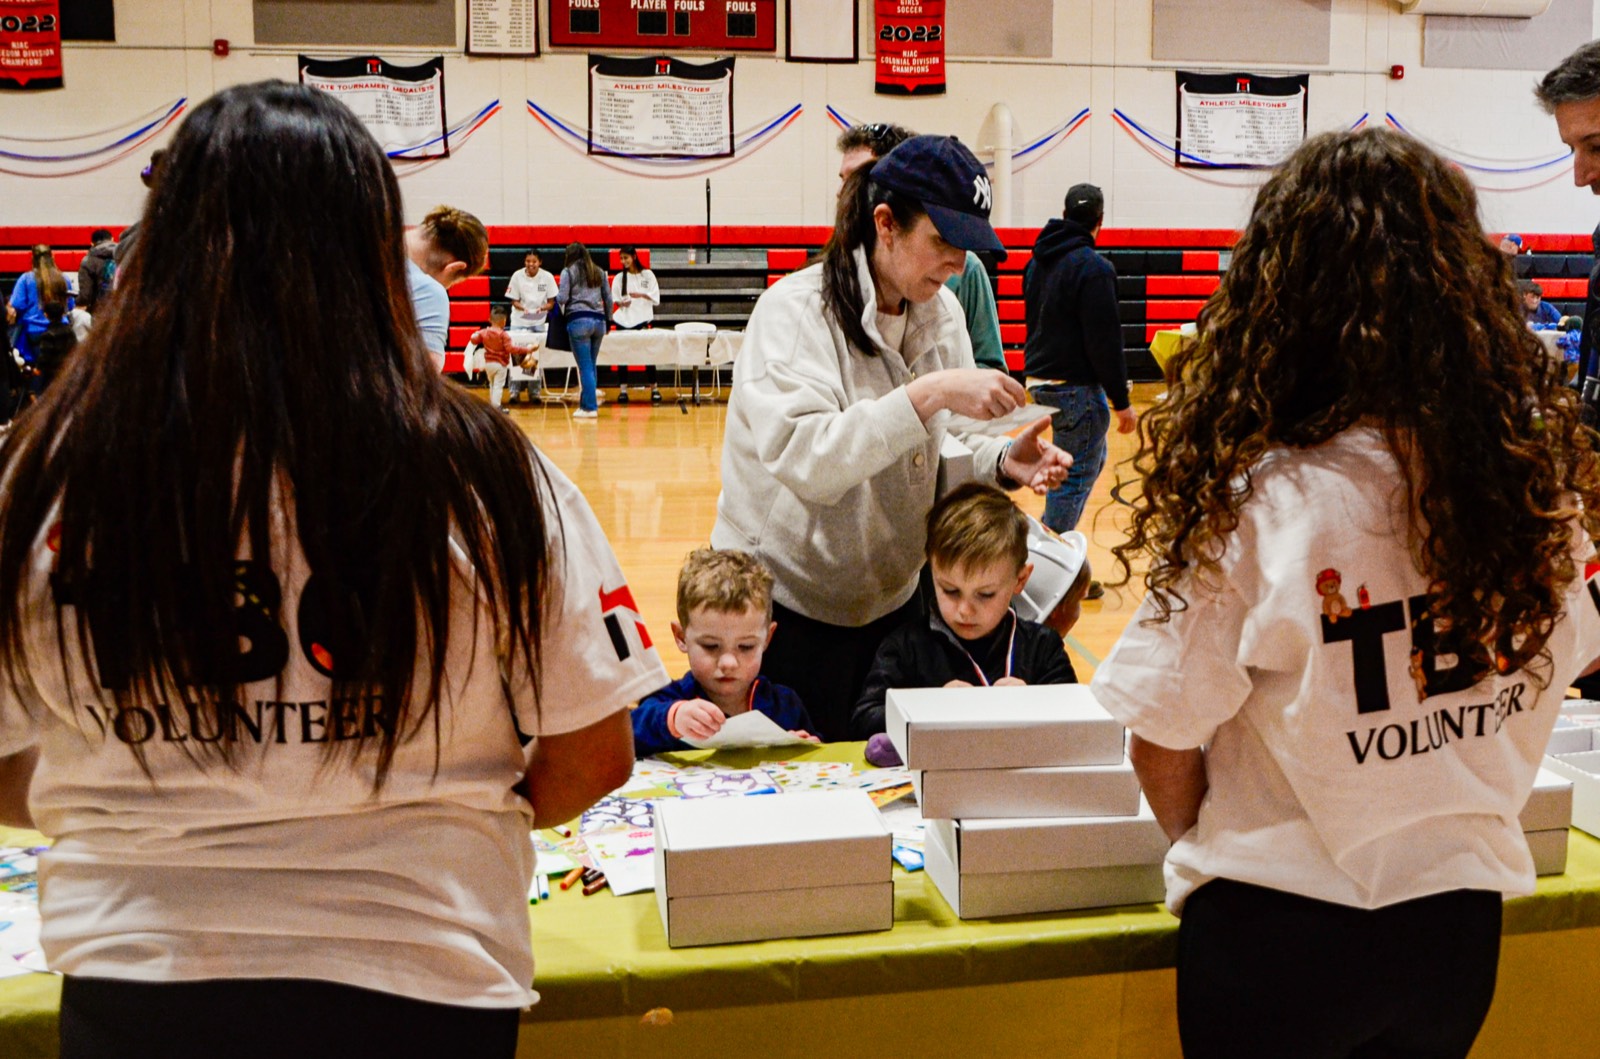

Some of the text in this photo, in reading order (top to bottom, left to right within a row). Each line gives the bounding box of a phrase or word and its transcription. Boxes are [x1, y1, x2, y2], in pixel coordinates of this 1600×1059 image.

[568, 0, 600, 8] FOULS
[630, 0, 705, 11] PLAYER FOULS
[726, 1, 757, 12] FOULS
[0, 14, 56, 32] 022
[880, 25, 942, 42] 2022
[0, 48, 54, 57] EDOM DIVISION
[1, 57, 43, 66] CHAMPIONS
[881, 57, 939, 65] COLONIAL DIVISION
[892, 65, 930, 73] CHAMPIONS
[337, 83, 390, 91] TOURNAMENT
[392, 85, 435, 94] MEDALISTS
[613, 83, 711, 93] ATHLETIC MILESTONES
[1239, 100, 1287, 108] MILESTONES
[85, 696, 392, 745] VOLUNTEER
[1346, 682, 1526, 765] VOLUNTEER
